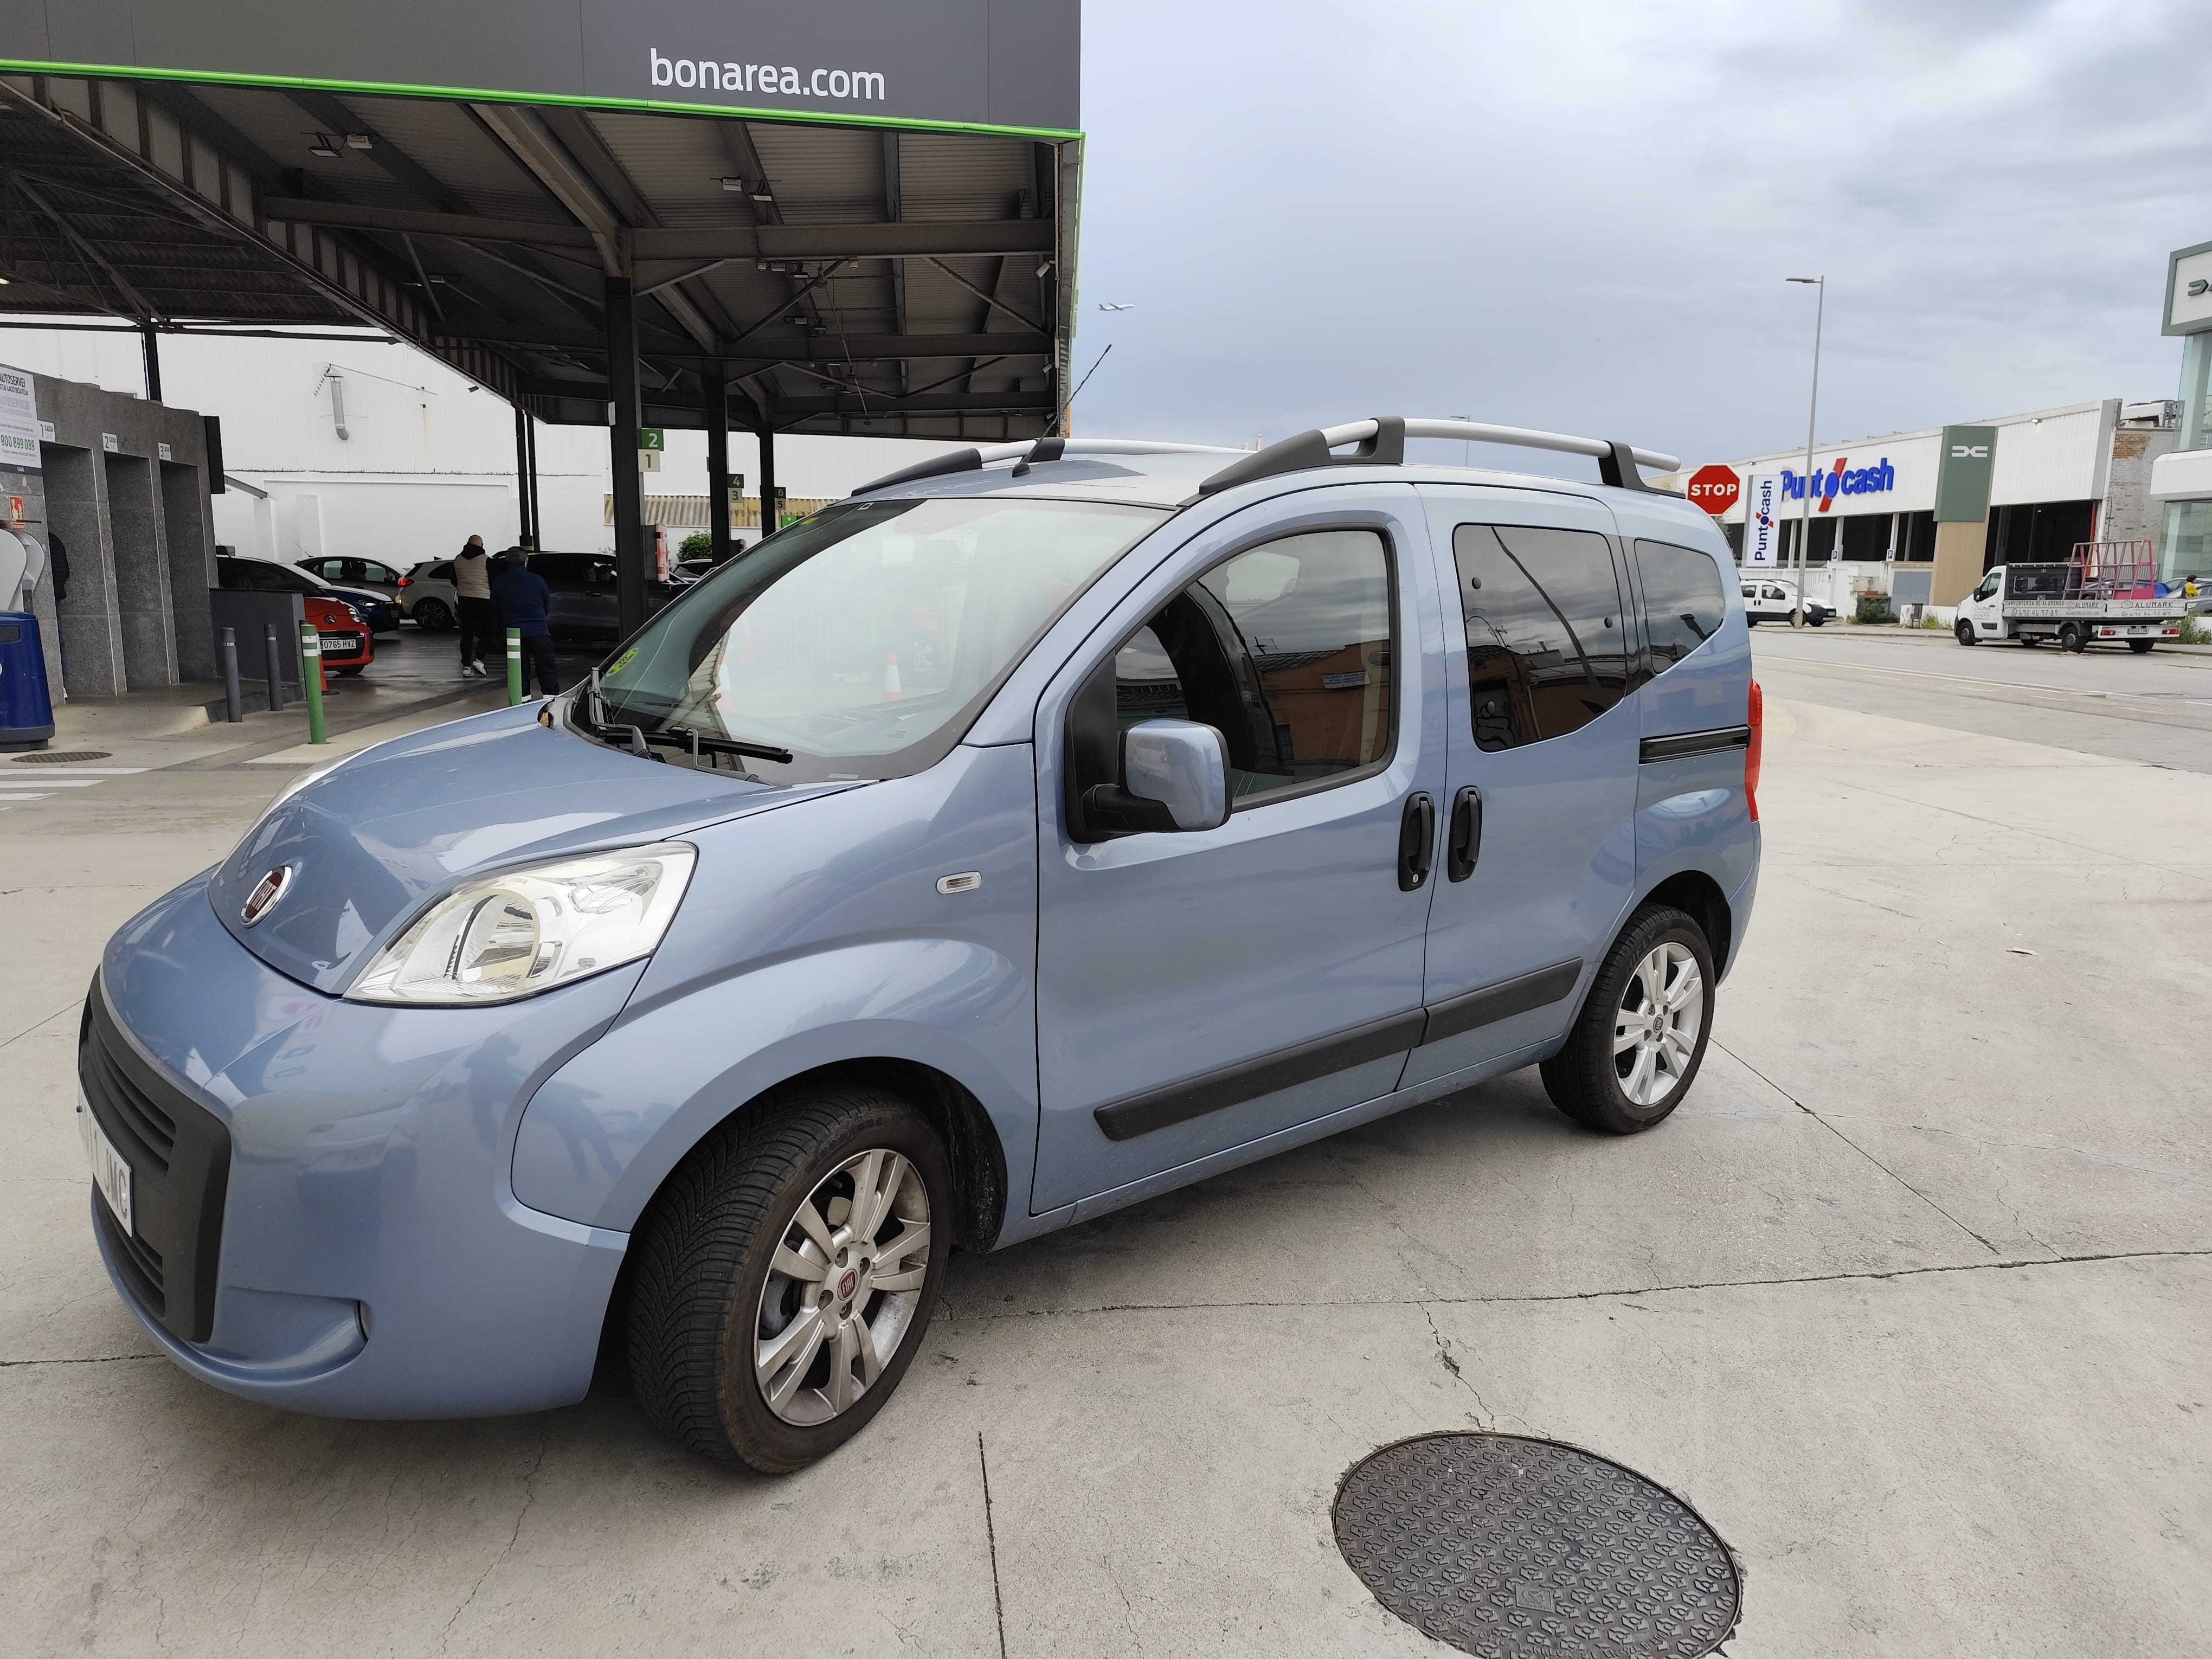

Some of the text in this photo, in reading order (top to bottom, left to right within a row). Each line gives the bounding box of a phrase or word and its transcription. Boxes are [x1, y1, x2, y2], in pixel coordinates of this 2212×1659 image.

[650, 47, 885, 100] bonarea.com
[1, 434, 35, 451] 900 899 089
[105, 435, 109, 449] 2
[648, 432, 659, 448] 2
[160, 445, 164, 457] 3
[645, 453, 651, 468] 1
[732, 476, 741, 487] 4
[732, 490, 738, 500] 3
[777, 489, 784, 497] 6
[1690, 484, 1737, 496] STOP
[777, 500, 783, 509] 5
[324, 640, 355, 649] 0765 HVZ
[249, 879, 278, 911] FIAT
[104, 1148, 128, 1220] JMC
[841, 1275, 854, 1295] FIAT
